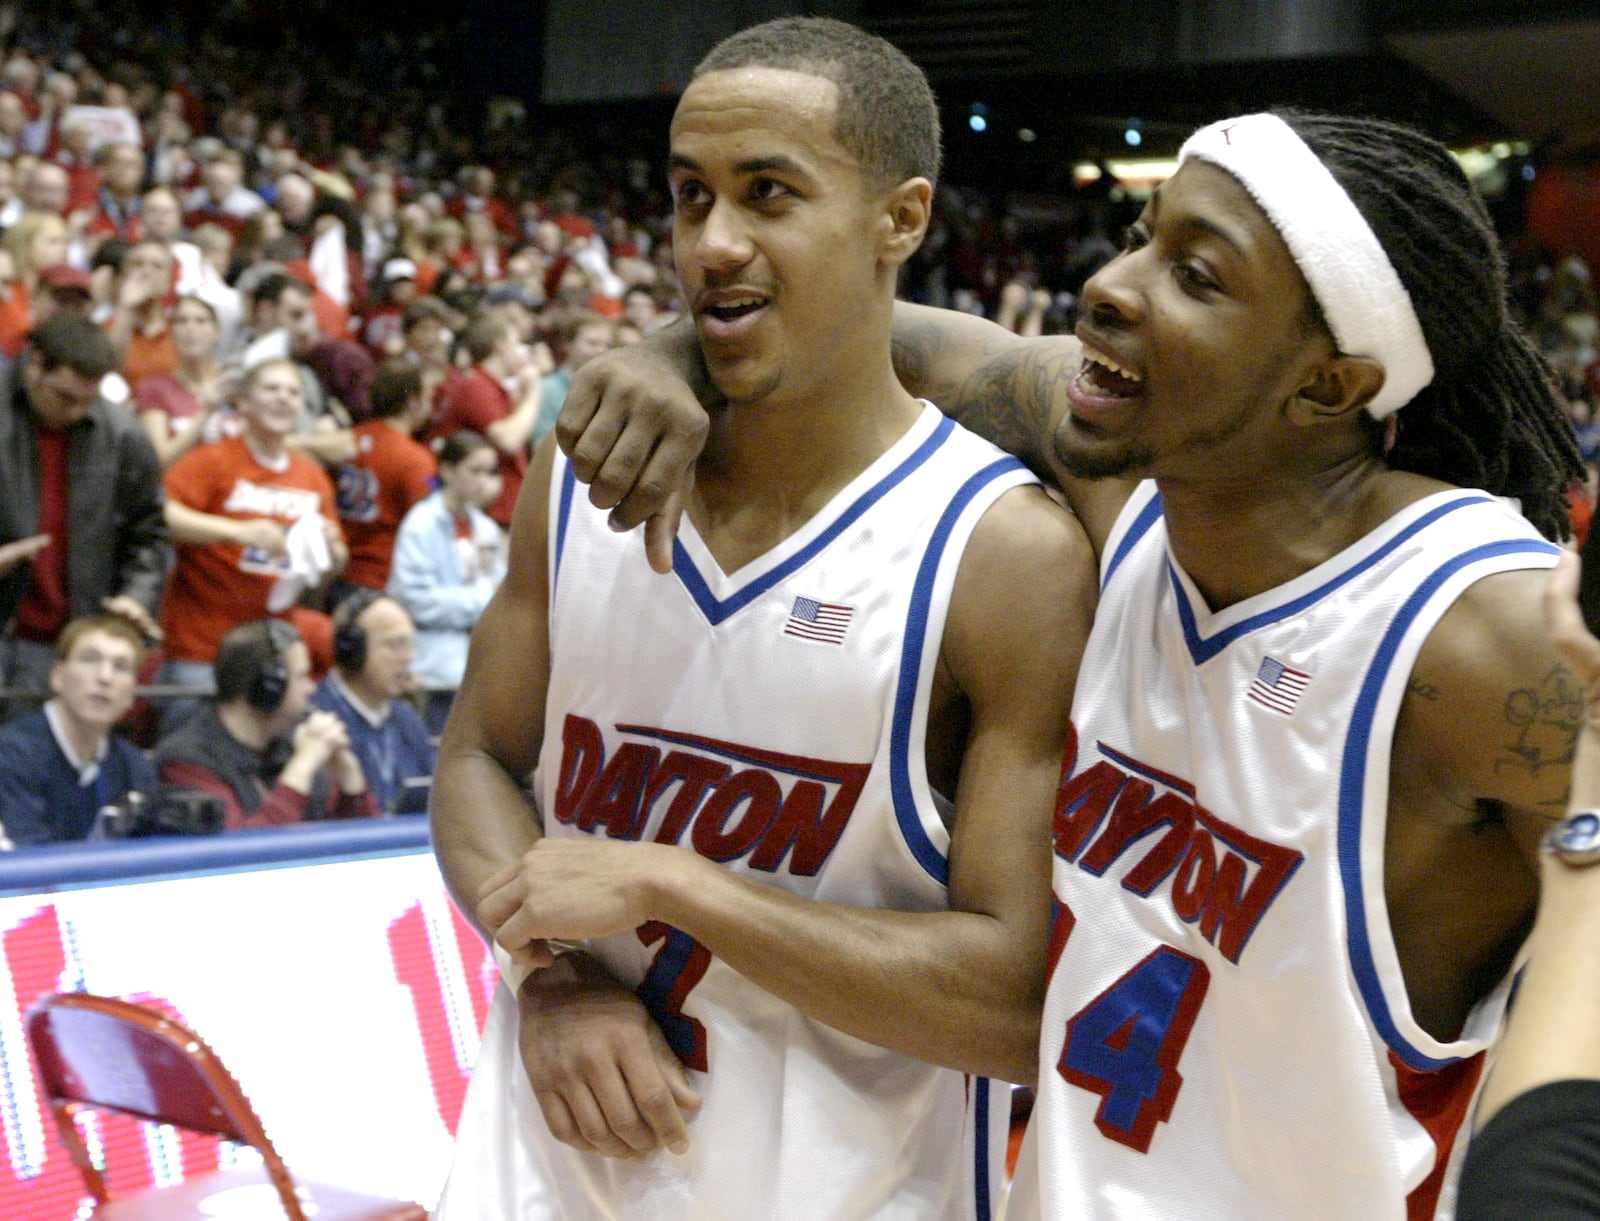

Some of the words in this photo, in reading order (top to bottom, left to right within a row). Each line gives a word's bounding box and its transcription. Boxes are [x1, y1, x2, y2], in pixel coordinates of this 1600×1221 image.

[554, 713, 873, 877] DAYTON
[1051, 718, 1305, 966] AYTON
[1045, 887, 1212, 1154] 4
